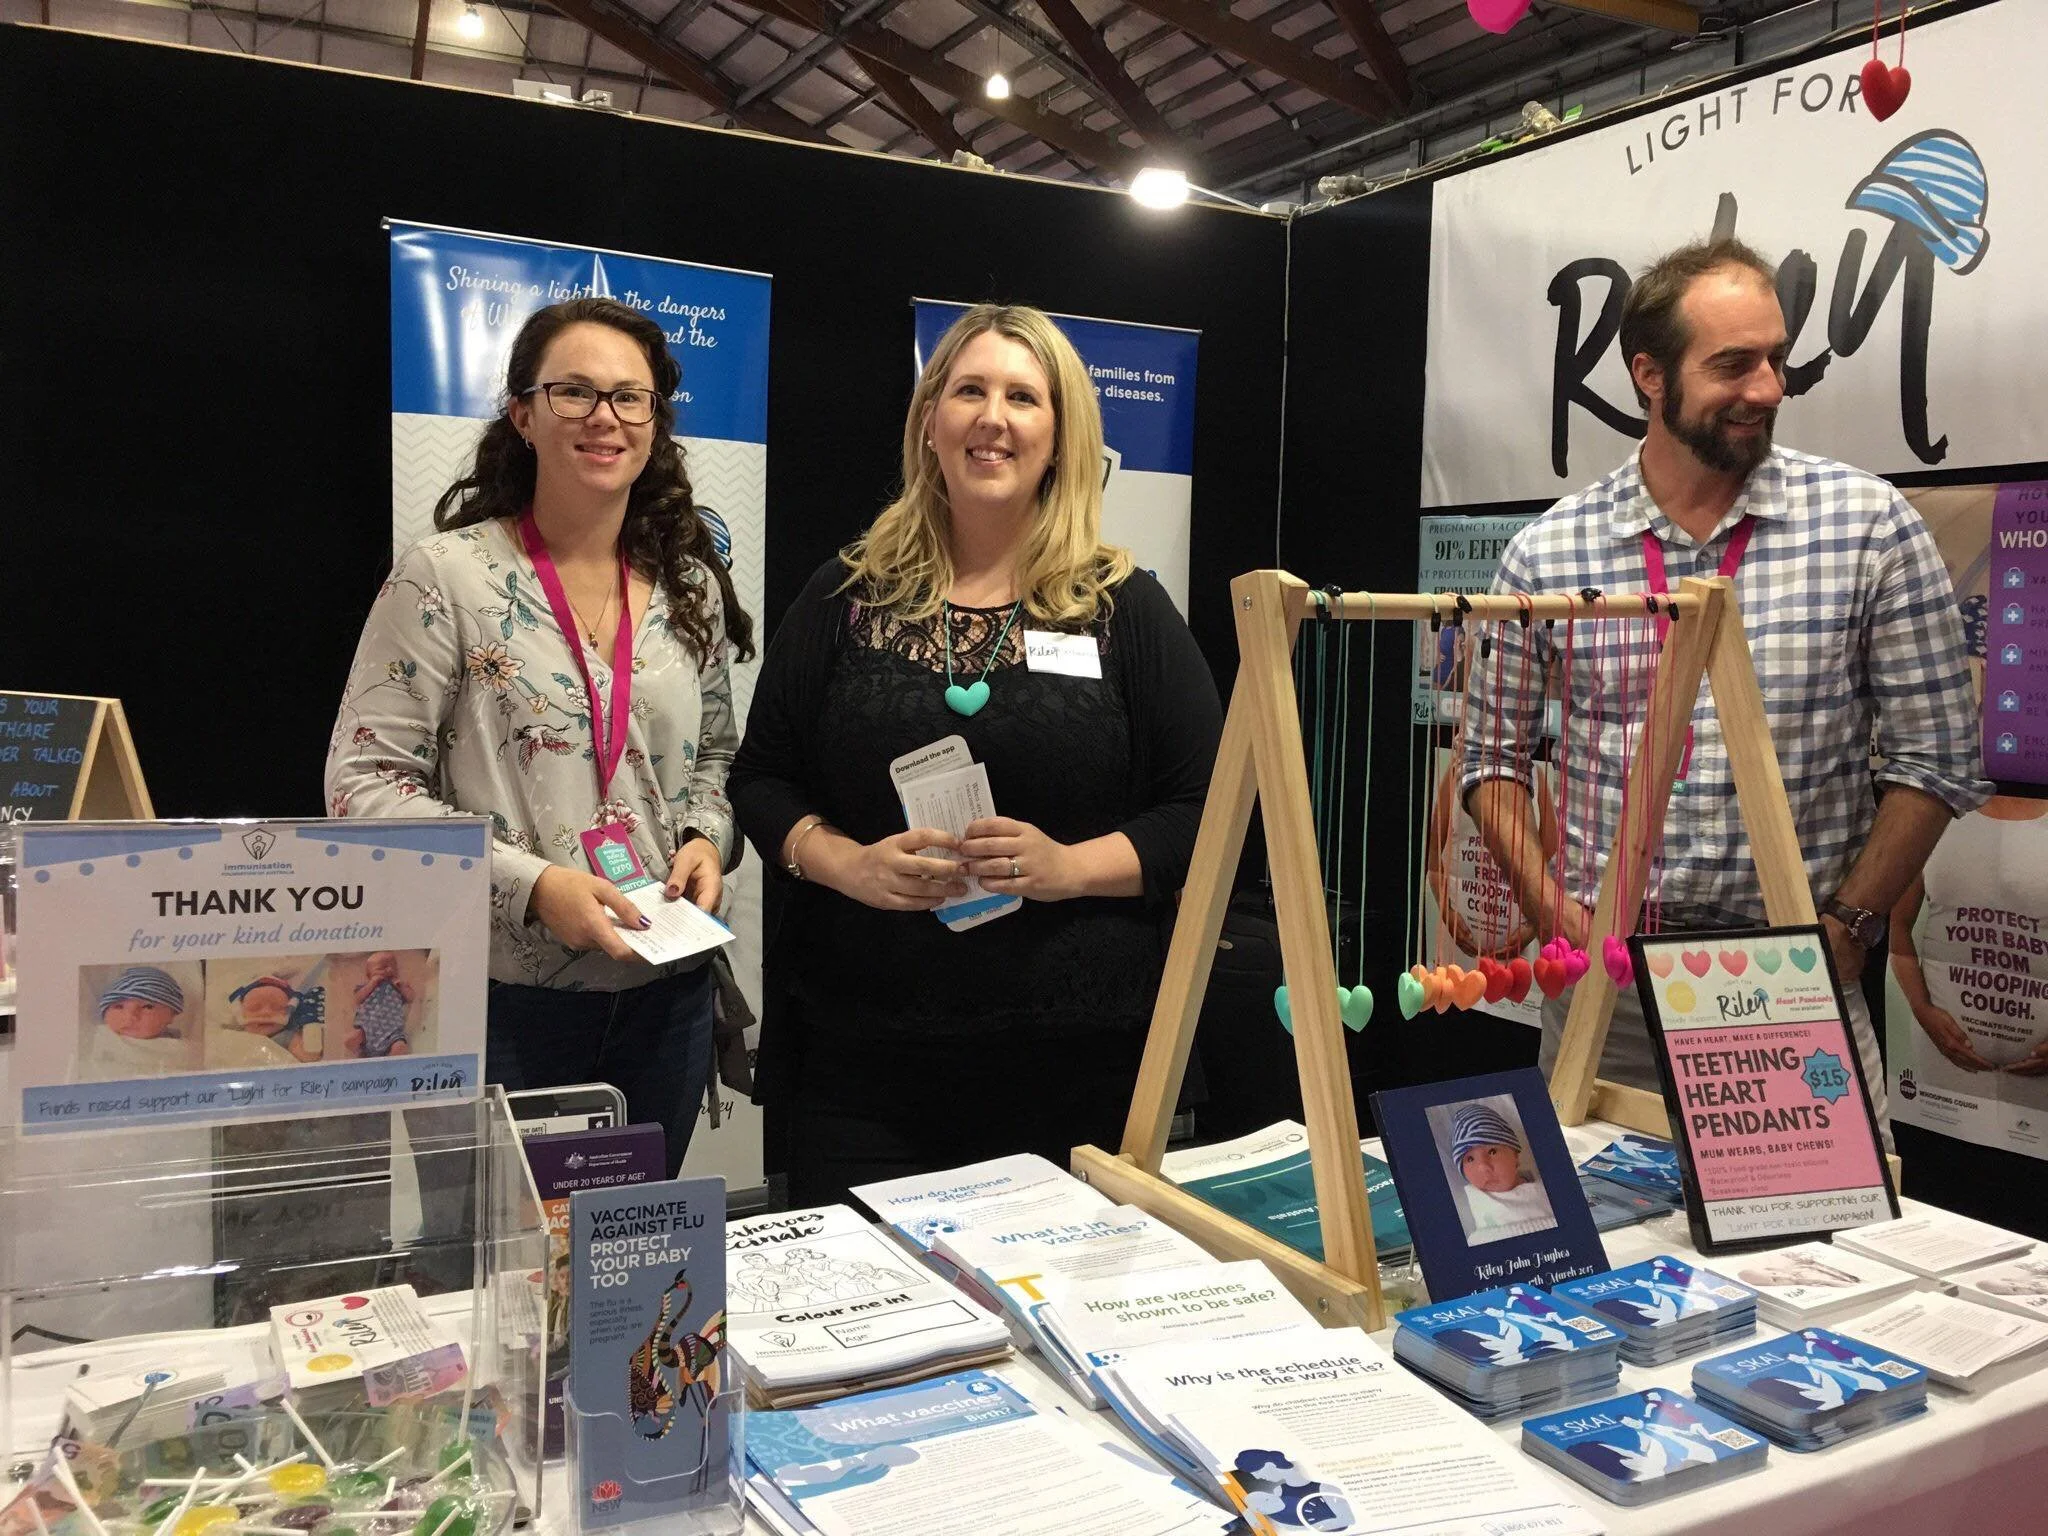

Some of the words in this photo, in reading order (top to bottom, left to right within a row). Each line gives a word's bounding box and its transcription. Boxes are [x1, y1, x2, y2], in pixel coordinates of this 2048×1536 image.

[1625, 87, 1749, 175] LIGHT
[1772, 72, 1863, 115] FOR
[446, 265, 525, 301] Shining
[529, 285, 543, 298] a
[623, 289, 653, 312] the
[657, 295, 727, 329] dangers
[688, 327, 718, 348] the
[1089, 364, 1141, 382] families
[1144, 369, 1176, 385] from
[1105, 384, 1165, 402] diseases.
[1429, 523, 1487, 534] PREGNANCY
[1435, 540, 1466, 561] 91%
[24, 698, 60, 716] YOUR
[33, 747, 83, 764] TALKED
[895, 755, 929, 774] Download
[928, 750, 941, 760] the
[941, 744, 956, 755] app
[10, 781, 59, 798] ABOUT
[224, 862, 292, 872] immunisation
[151, 887, 277, 917] THANK
[286, 884, 364, 912] YOU
[1956, 906, 2040, 934] PROTECT
[128, 928, 165, 952] for
[172, 931, 226, 953] your
[232, 923, 284, 945] kind
[288, 921, 384, 943] donation
[1945, 925, 1998, 946] YOUR
[2002, 931, 2048, 954] BABY
[1971, 947, 2030, 974] FROM
[1949, 965, 2048, 1001] WHOOPING
[1716, 989, 1772, 1022] Riley
[1960, 990, 2037, 1021] COUGH.
[1674, 1037, 1695, 1047] HAVE
[1733, 1033, 1754, 1043] MAKE
[1764, 1029, 1811, 1041] DIFFERENCE!
[1676, 1046, 1800, 1078] TEETHING
[1809, 1068, 1845, 1089] $15
[39, 1101, 81, 1117] Funds
[88, 1096, 131, 1113] raised
[137, 1090, 190, 1112] support
[197, 1091, 216, 1104] our
[272, 1085, 292, 1097] for
[340, 1075, 398, 1099] campaign
[1684, 1078, 1768, 1108] HEART
[1691, 1104, 1831, 1139] PENDANTS
[1700, 1149, 1725, 1159] MUM
[1727, 1146, 1766, 1157] WEARS,
[1767, 1143, 1794, 1153] BABY
[1796, 1139, 1835, 1151] CHEWS!
[552, 1179, 579, 1190] UNDER
[580, 1178, 590, 1188] 20
[591, 1175, 614, 1186] YEARS
[615, 1174, 625, 1183] OF
[626, 1171, 646, 1182] AGE?
[888, 1194, 925, 1206] How
[927, 1187, 948, 1198] do
[949, 1175, 1013, 1193] vaccines
[937, 1189, 977, 1204] affect
[1711, 1207, 1746, 1217] THANK
[1749, 1205, 1769, 1214] YOU
[1771, 1202, 1794, 1212] FOR
[1796, 1198, 1859, 1210] SUPPORTING
[1860, 1193, 1881, 1203] OUR
[590, 1201, 687, 1225] VACCINATE
[1762, 1218, 1785, 1230] FOR
[1822, 1208, 1874, 1225] CAMPAIGN!
[590, 1220, 668, 1241] AGAINST
[672, 1215, 705, 1230] FLU
[726, 1213, 825, 1239] erheroes
[992, 1226, 1059, 1245] What
[1061, 1223, 1080, 1235] is
[1084, 1220, 1112, 1232] in
[1042, 1221, 1149, 1247] vaccines?
[590, 1234, 672, 1258] PROTECT
[590, 1252, 641, 1273] YOUR
[645, 1247, 692, 1266] BABY
[1474, 1263, 1505, 1281] Riley
[1504, 1256, 1532, 1275] John
[1532, 1247, 1571, 1269] Hughes
[590, 1271, 629, 1290] TOO
[1545, 1266, 1578, 1284] March
[1578, 1264, 1595, 1276] 2015
[775, 1307, 844, 1324] Colour
[849, 1300, 882, 1313] me
[883, 1293, 913, 1305] in!
[1084, 1297, 1133, 1314] How
[1135, 1294, 1165, 1306] are
[1167, 1281, 1247, 1303] vaccines
[1116, 1304, 1179, 1324] shown
[1181, 1302, 1204, 1314] to
[1207, 1298, 1230, 1311] be
[1232, 1289, 1276, 1308] safe?
[590, 1316, 627, 1326] especially
[834, 1322, 871, 1334] Name
[590, 1333, 625, 1344] pregnant
[844, 1333, 869, 1345] Age
[1165, 1374, 1213, 1387] Why
[1216, 1370, 1235, 1381] is
[1237, 1366, 1272, 1379] the
[1274, 1356, 1362, 1374] schedule
[1261, 1374, 1296, 1386] the
[1299, 1368, 1339, 1381] way
[1340, 1365, 1358, 1376] it
[1360, 1361, 1385, 1374] is?
[831, 1413, 902, 1434] What
[901, 1393, 1003, 1419] vaccines
[963, 1406, 1012, 1423] Birth?
[592, 1500, 621, 1514] NSW
